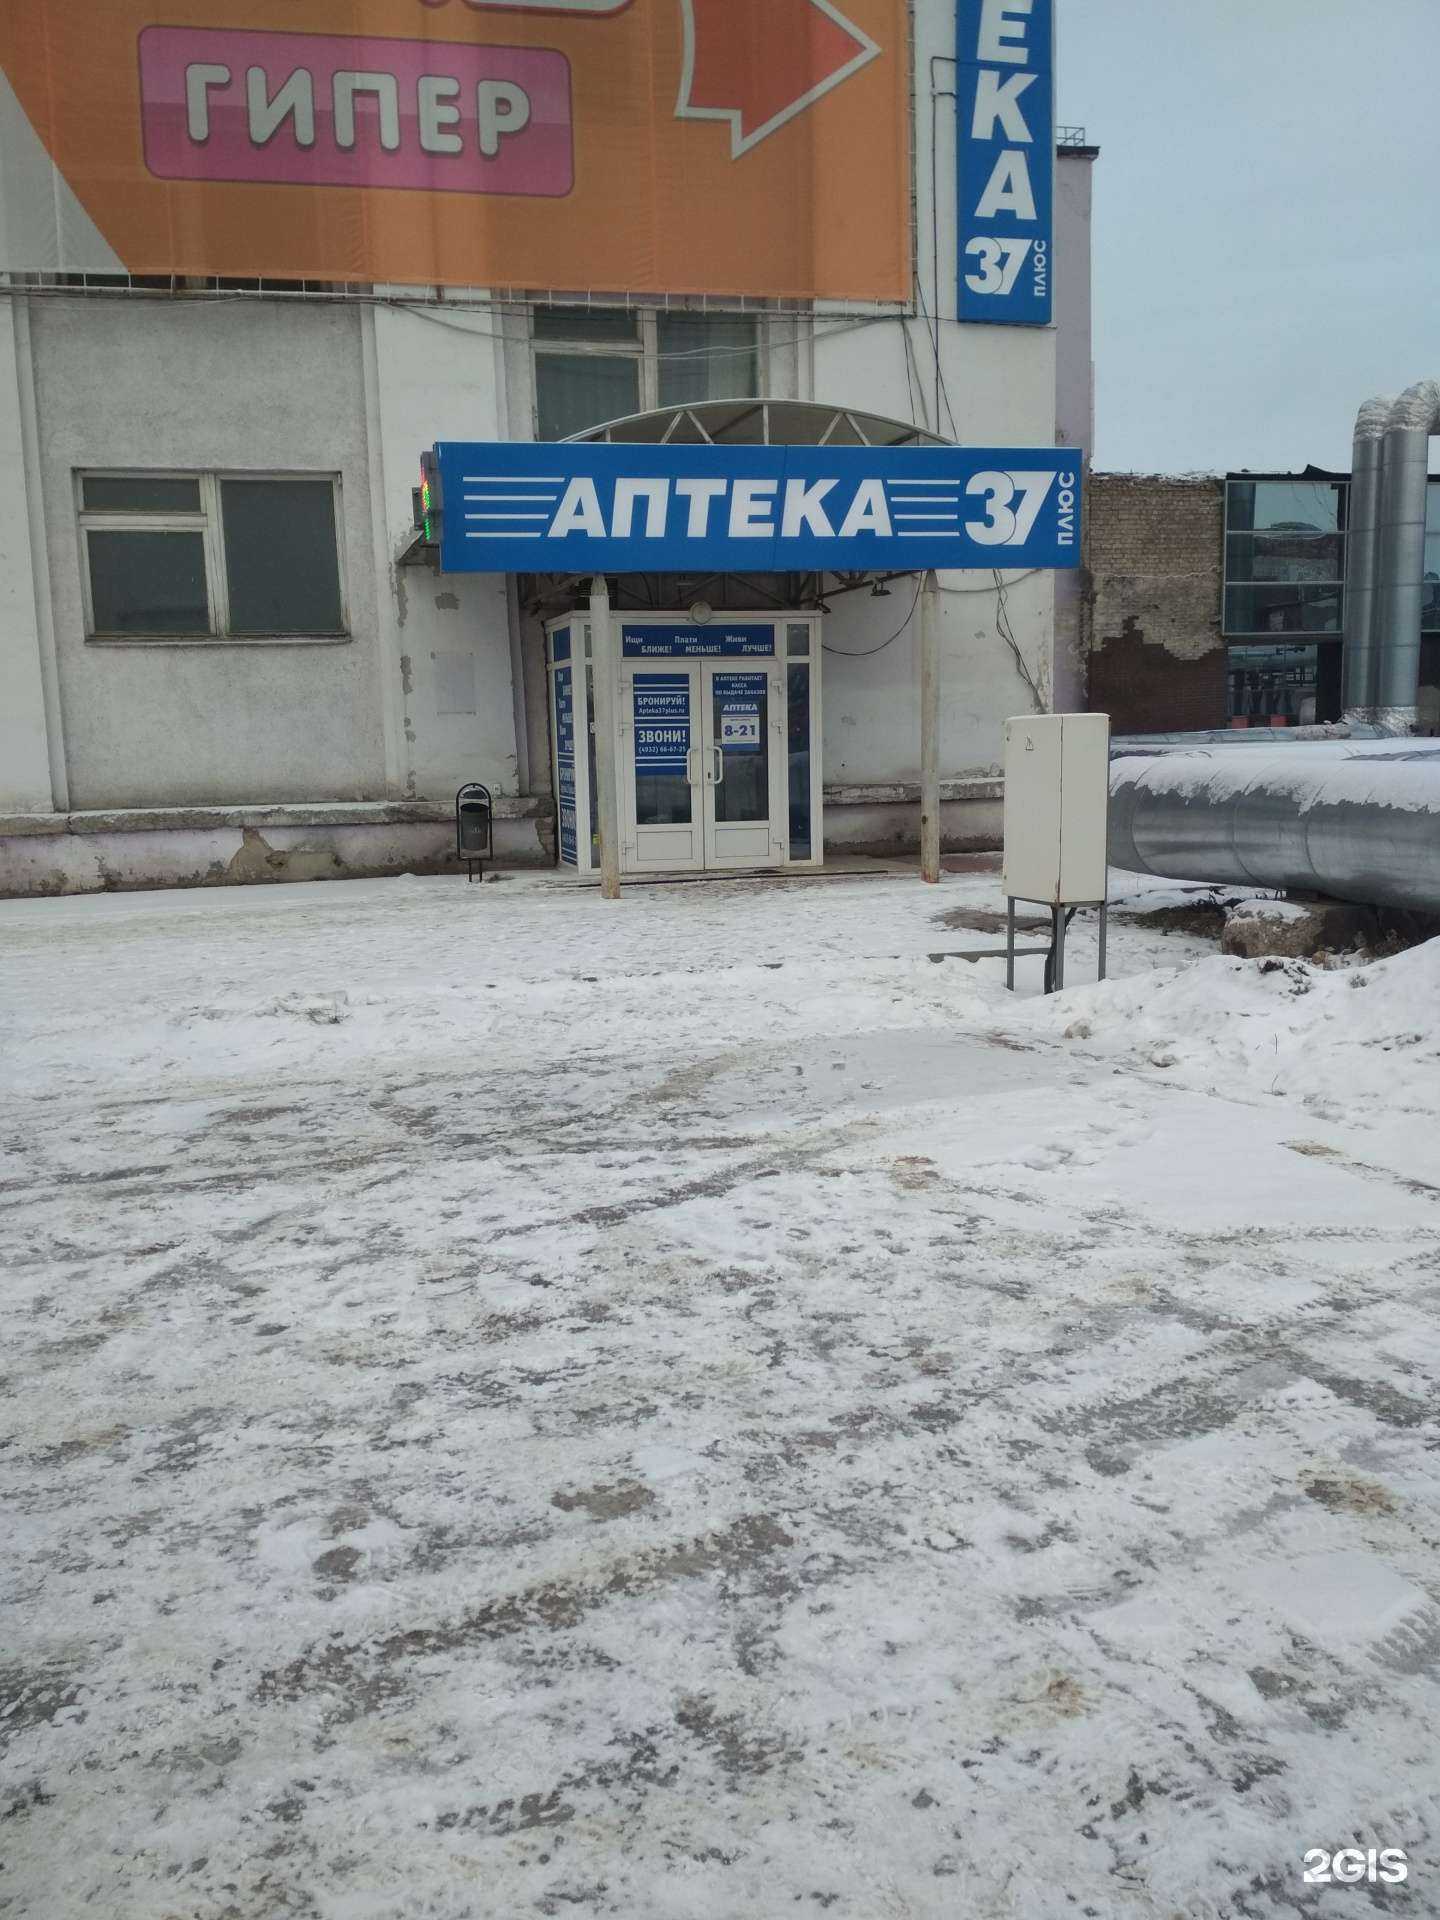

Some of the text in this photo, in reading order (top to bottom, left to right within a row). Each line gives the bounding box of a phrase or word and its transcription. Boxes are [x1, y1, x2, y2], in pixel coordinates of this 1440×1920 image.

[185, 63, 532, 157] ГИПЕР
[964, 236, 1033, 295] 37
[1034, 239, 1047, 297] ПЛЮС
[547, 471, 1057, 546] АПТЕКА 37
[1057, 471, 1075, 546] ПЛЮС
[625, 635, 643, 645] Ищи
[674, 635, 698, 643] Плати
[725, 635, 747, 643] Живи
[641, 645, 672, 653] БЛИЖЕ!
[685, 645, 721, 653] МЕНЬШЕ!
[741, 644, 772, 652] ЛУЧШЕ!
[637, 694, 686, 706] БРОНИРУЙ!
[723, 703, 758, 711] АПТЕКА
[724, 725, 755, 736] 8-21
[638, 730, 686, 743] ЗВОНИ!
